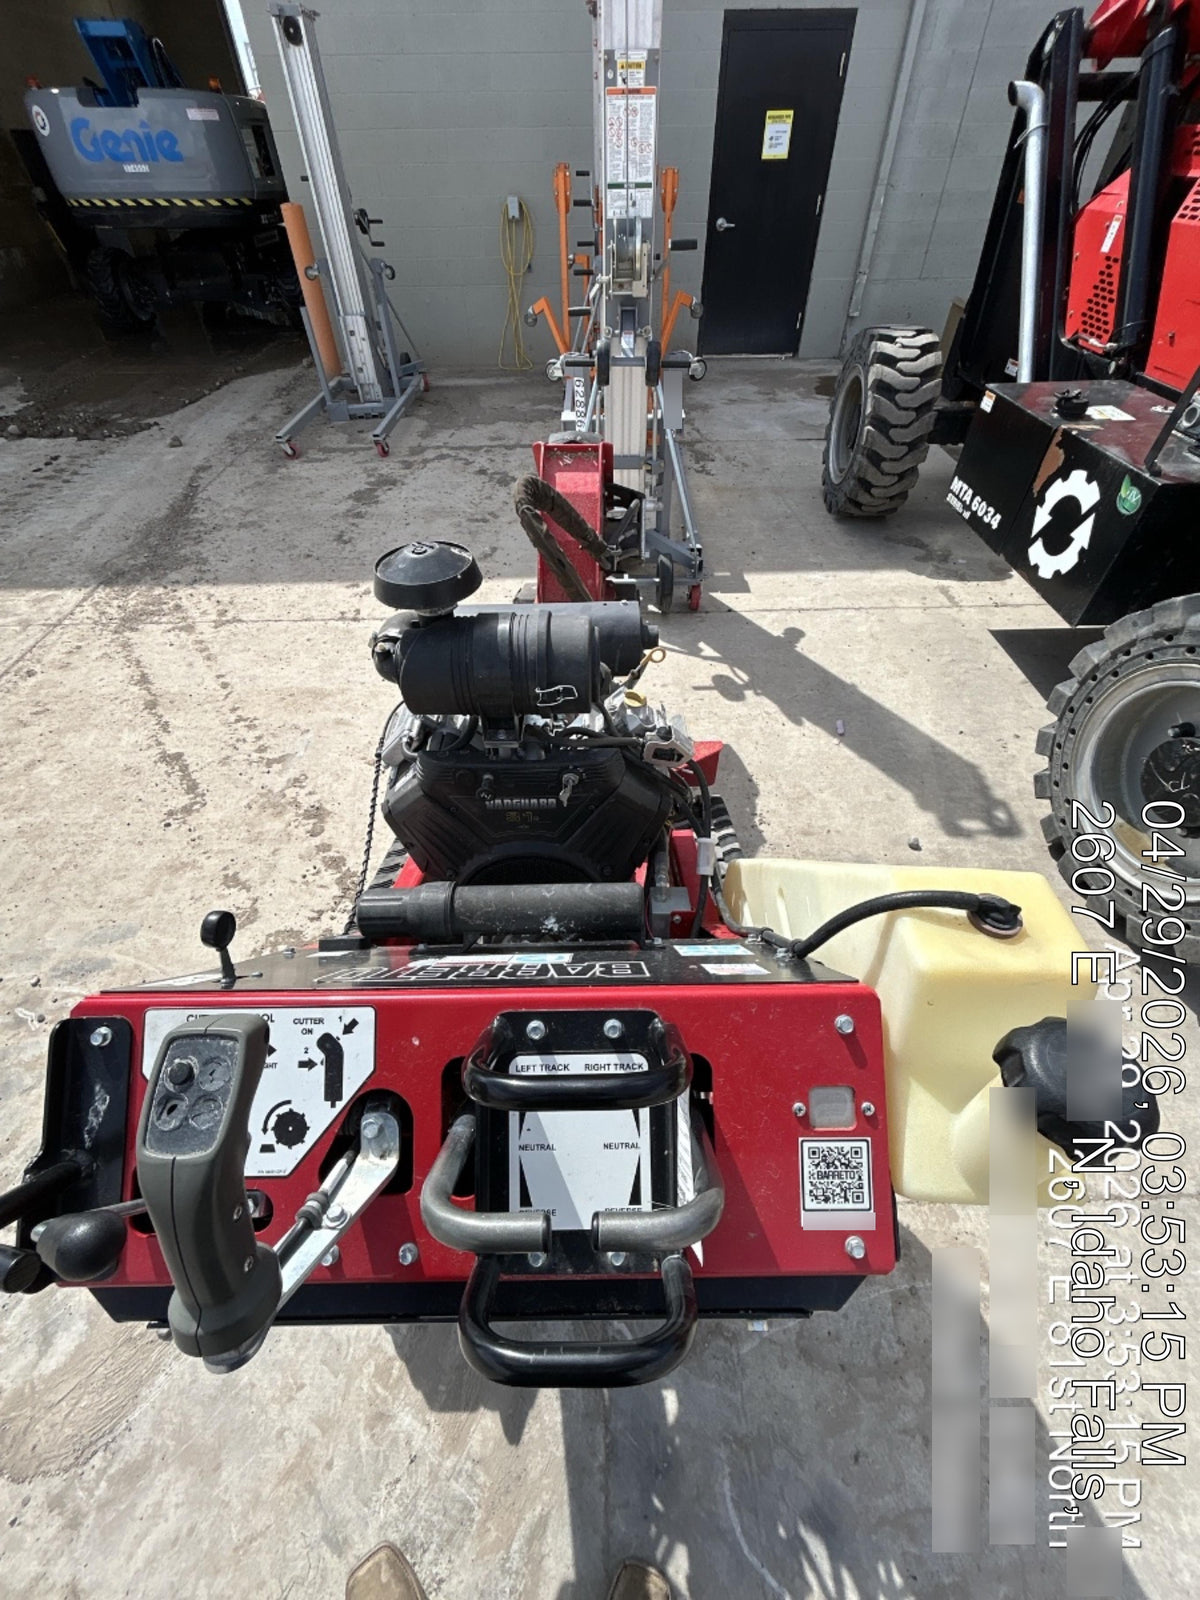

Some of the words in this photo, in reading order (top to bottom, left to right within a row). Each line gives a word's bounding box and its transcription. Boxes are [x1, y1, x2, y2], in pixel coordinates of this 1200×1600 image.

[70, 116, 184, 162] Genie
[575, 379, 586, 432] 62886
[950, 476, 973, 509] MTA
[971, 496, 1002, 530] 6034
[293, 1017, 325, 1025] CUTTER
[515, 1064, 537, 1072] LEFT
[539, 1063, 570, 1072] TRACK
[584, 1063, 611, 1071] RIGHT
[613, 1063, 643, 1071] TRACK
[518, 1143, 556, 1152] NEUTRAL
[603, 1142, 641, 1150] NEUTRAL
[817, 1170, 855, 1180] BARRETO
